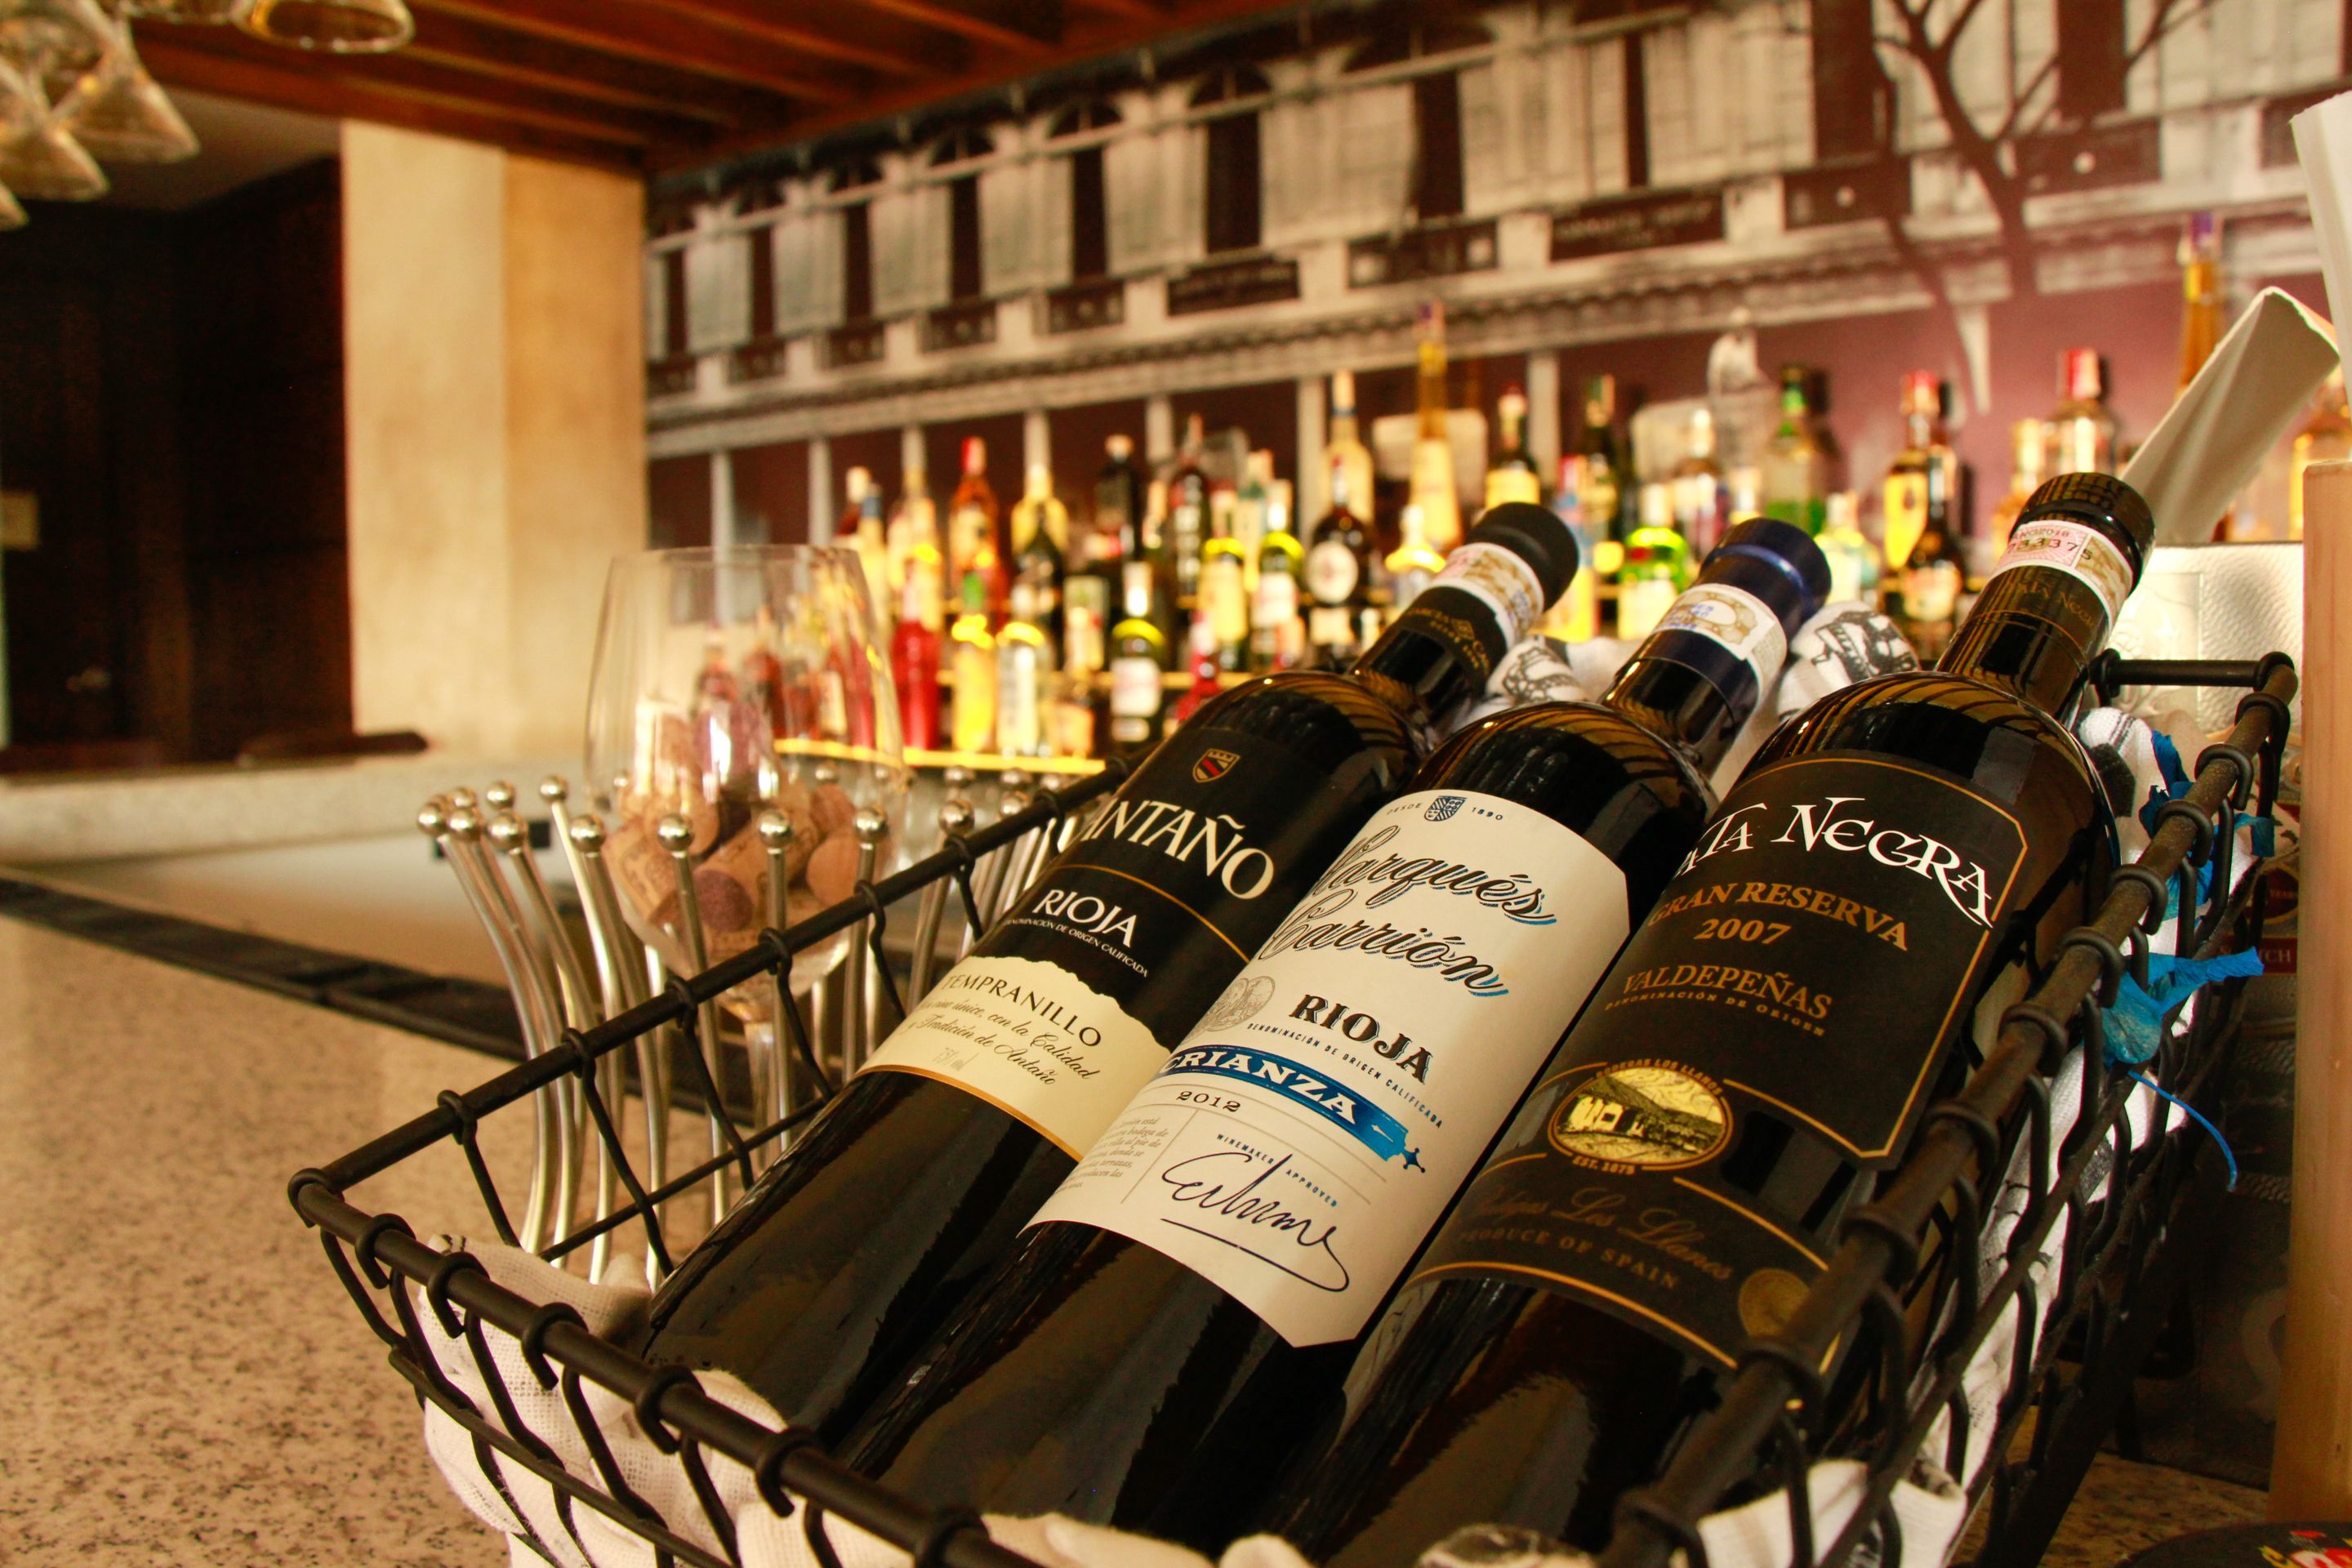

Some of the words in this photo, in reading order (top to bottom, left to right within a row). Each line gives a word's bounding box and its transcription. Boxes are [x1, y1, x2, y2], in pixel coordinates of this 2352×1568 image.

[1387, 802, 1423, 815] DESDE
[1471, 806, 1503, 821] 1890
[1673, 802, 1767, 880] ATA
[1771, 797, 1993, 929] NEGRA
[1032, 889, 1137, 947] RIOJA
[1258, 889, 1509, 997] Carrión
[1648, 882, 1739, 927] GRAN
[1735, 882, 1908, 951] RESERVA
[1694, 918, 1793, 945] 2007
[1055, 924, 1070, 933] DE
[1068, 929, 1100, 947] ORIGEN
[1102, 943, 1148, 978] CALIFICADA
[941, 974, 1102, 1048] TEMPRANILLO
[1605, 991, 1717, 1011] DENOMINACIÓN
[1725, 996, 1747, 1008] DE
[1757, 1004, 1825, 1037] ORIGEN
[1622, 964, 1833, 1019] VALDEPEÑAS
[916, 1013, 976, 1039] Tradición
[974, 1033, 997, 1047] de
[993, 1044, 1057, 1085] Antaño
[987, 1013, 1012, 1027] con
[1011, 1021, 1031, 1036] la
[1030, 1031, 1101, 1080] Calidad
[1288, 994, 1433, 1085] RIOJA
[1160, 1049, 1357, 1125] CRIANZA
[1175, 1089, 1242, 1113] 2012
[1246, 1022, 1321, 1047] DENOMINACIÓN
[1325, 1044, 1339, 1055] DE
[1342, 1053, 1382, 1080] ORIGEN
[1385, 1078, 1444, 1129] CALIFICADA
[1655, 1058, 1679, 1069] LOS
[1680, 1064, 1725, 1096] LLANOS
[1217, 1133, 1275, 1165] WINEMAKER
[1285, 1169, 1339, 1208] APPROVED
